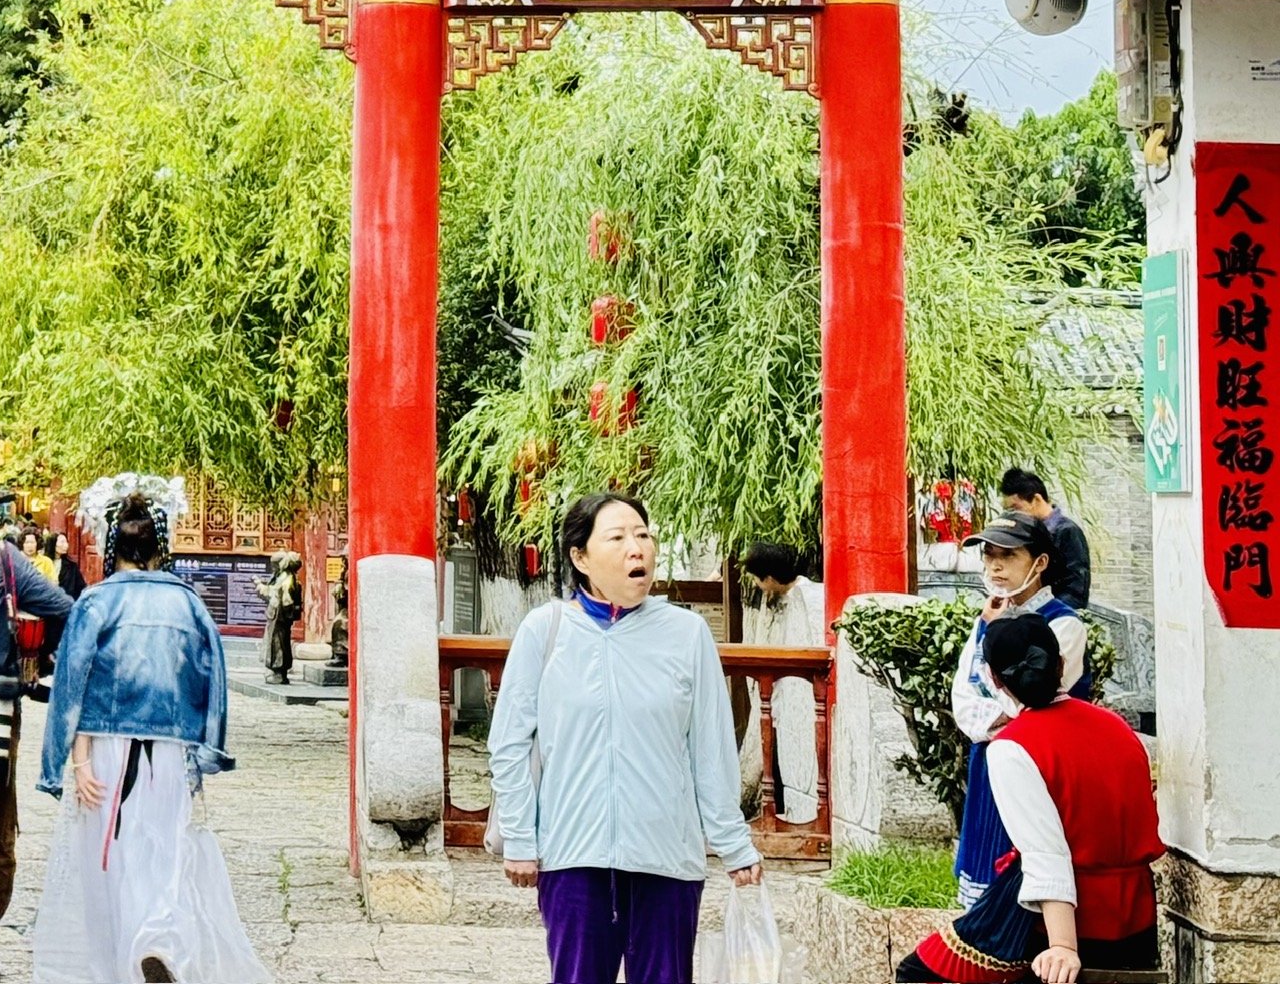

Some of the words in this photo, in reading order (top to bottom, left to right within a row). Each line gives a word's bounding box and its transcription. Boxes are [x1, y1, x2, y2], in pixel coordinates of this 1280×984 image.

[1203, 173, 1278, 600] 人興財旺福臨門
